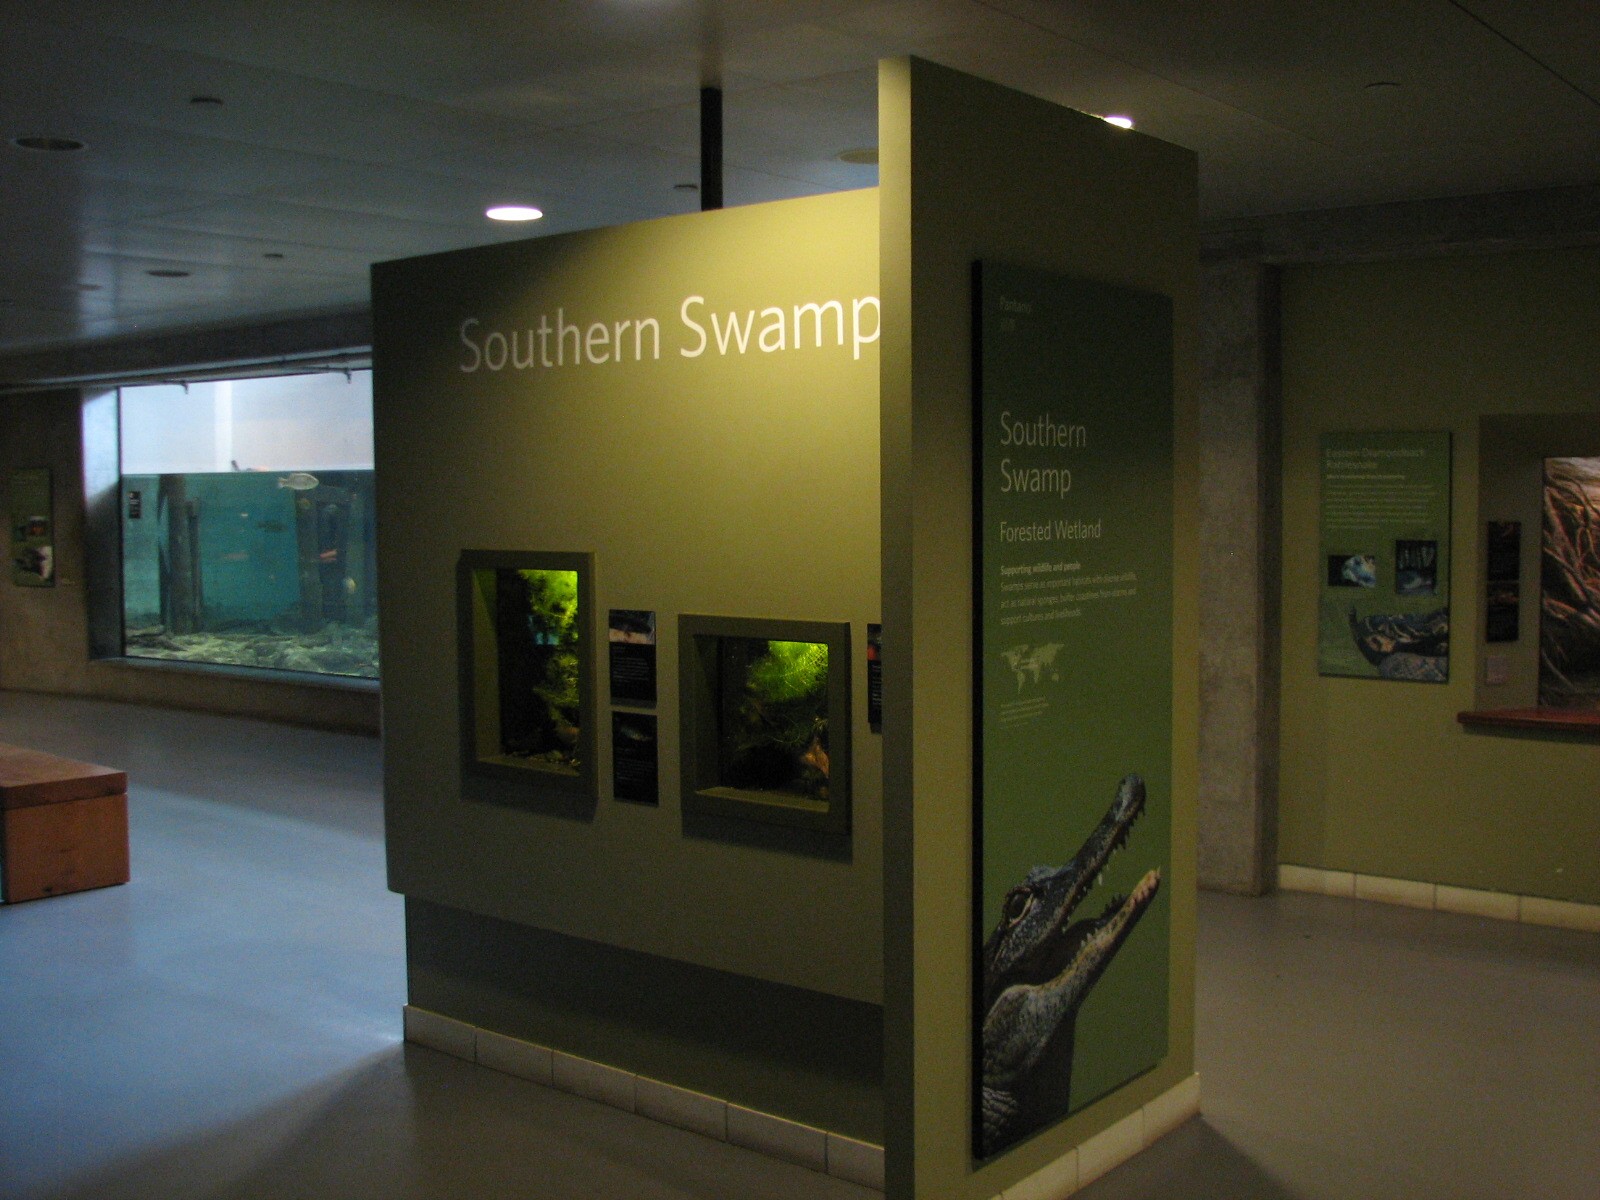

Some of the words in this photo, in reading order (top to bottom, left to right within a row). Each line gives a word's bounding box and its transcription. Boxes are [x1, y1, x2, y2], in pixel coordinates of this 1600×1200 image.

[458, 307, 661, 374] Southern
[679, 295, 881, 361] Swamp
[1000, 410, 1087, 448] Southern
[1000, 458, 1072, 500] Swamp
[1000, 519, 1051, 542] Forested
[1054, 517, 1102, 541] Wetland
[1000, 564, 1032, 577] Supporting
